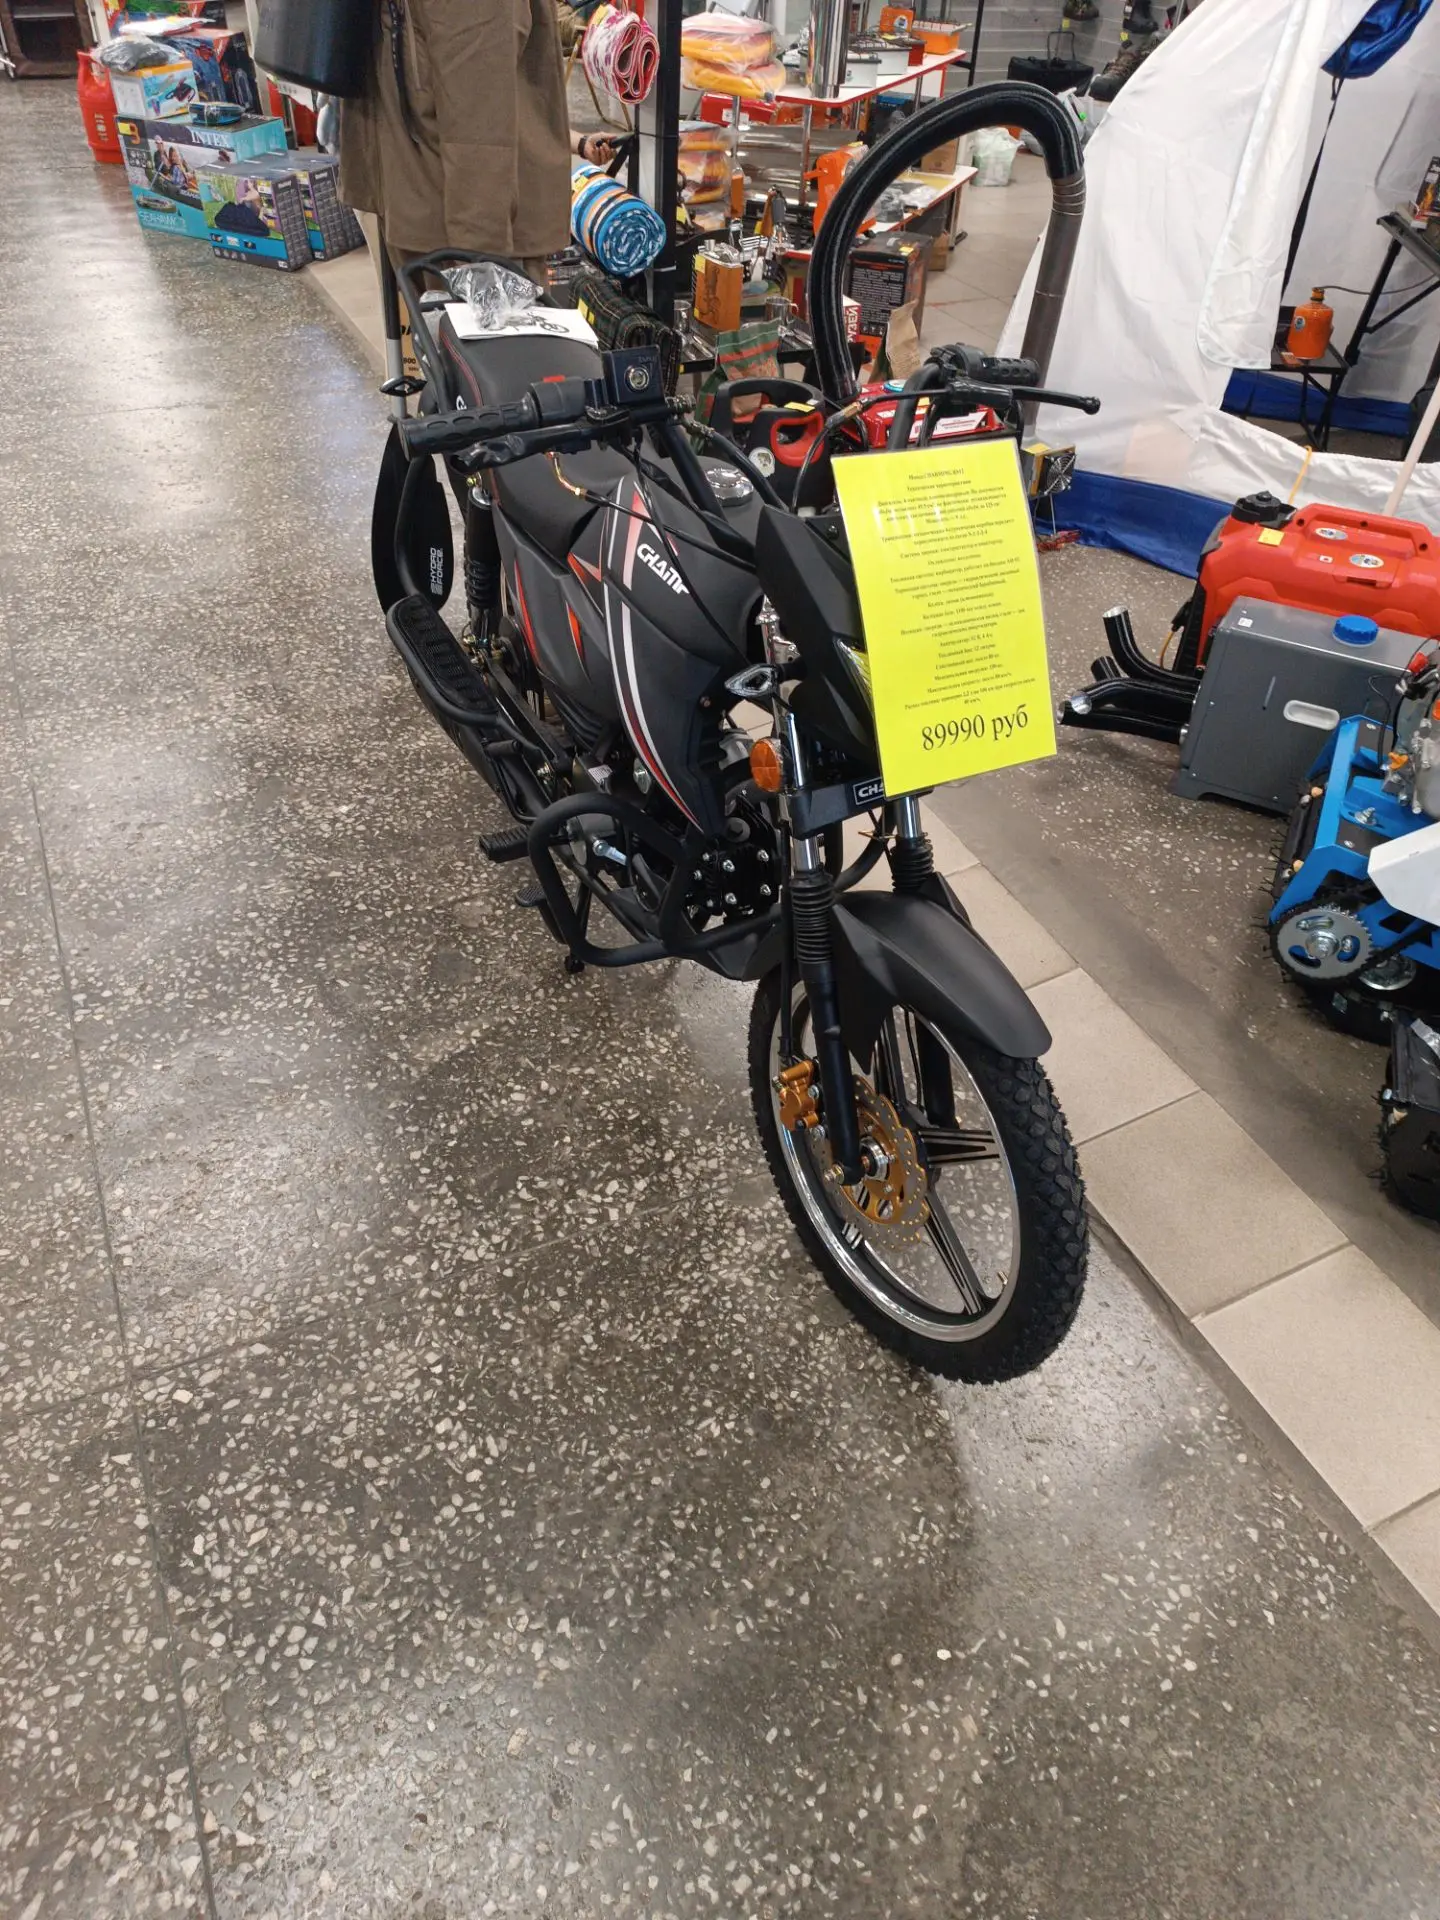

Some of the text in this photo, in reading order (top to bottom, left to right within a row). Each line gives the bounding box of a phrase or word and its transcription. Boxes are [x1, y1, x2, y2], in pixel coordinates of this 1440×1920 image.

[191, 130, 231, 149] INTEX
[436, 549, 444, 585] FORCE
[921, 704, 1029, 751] 89990 руб
